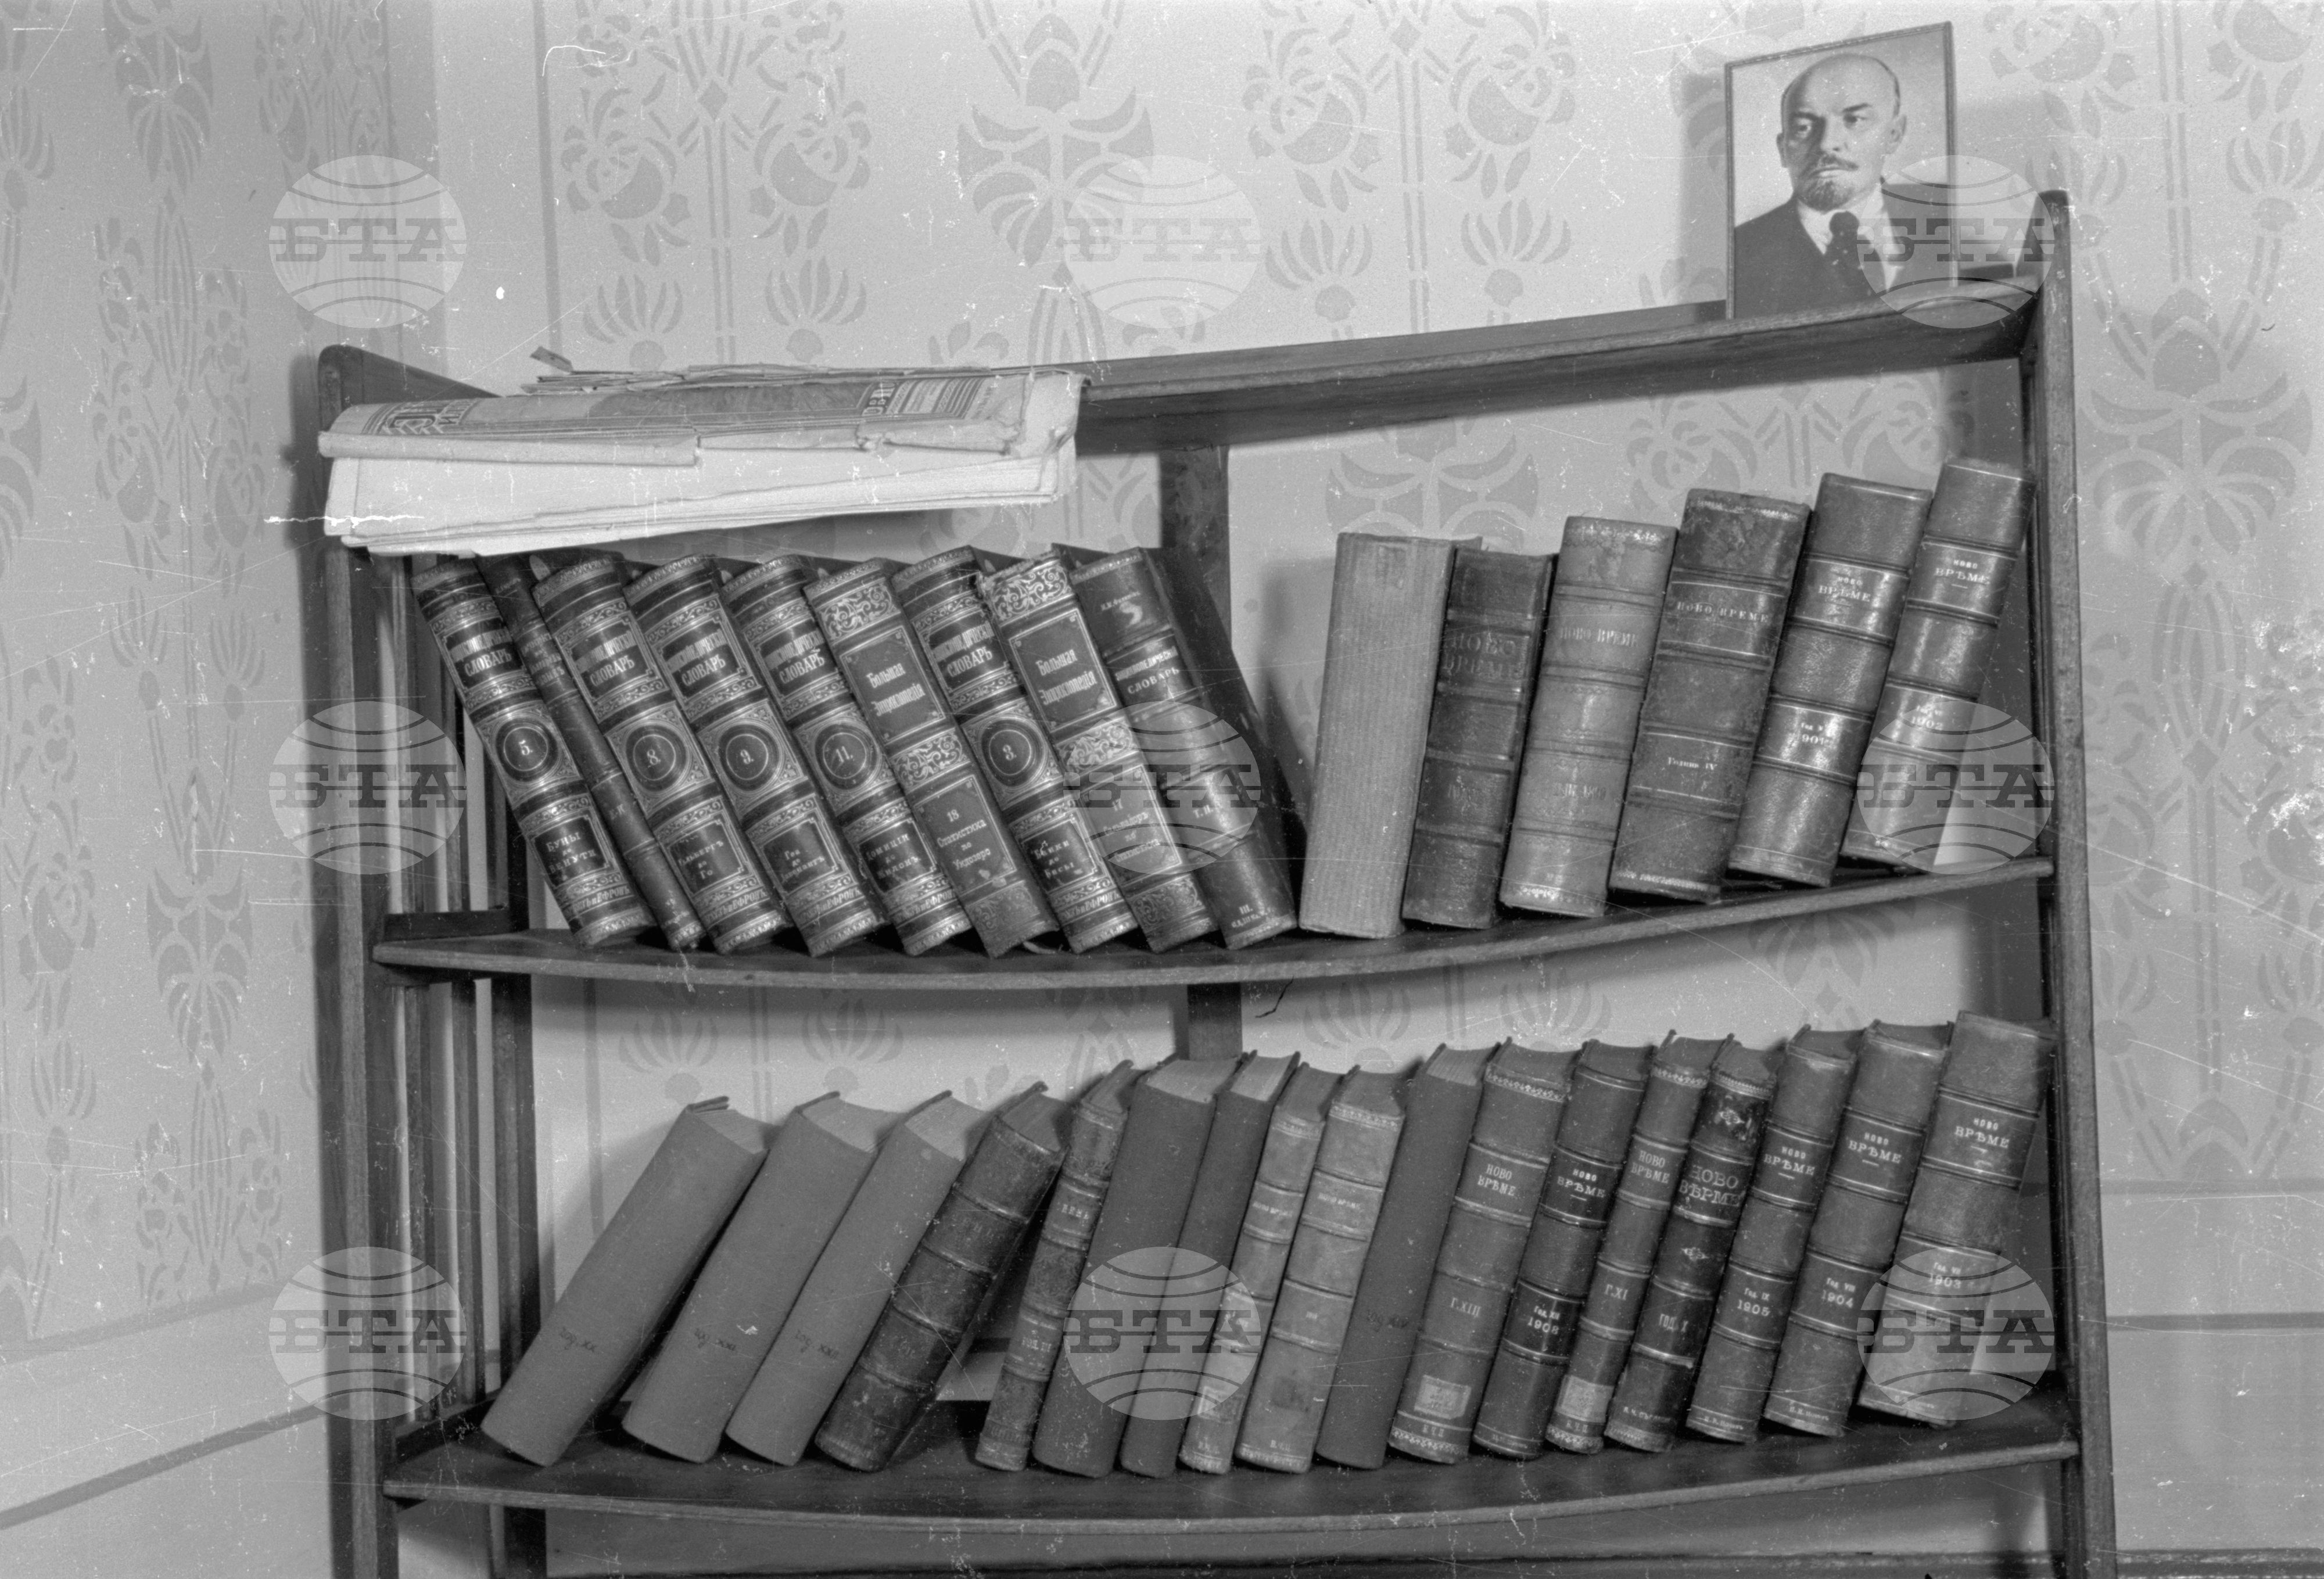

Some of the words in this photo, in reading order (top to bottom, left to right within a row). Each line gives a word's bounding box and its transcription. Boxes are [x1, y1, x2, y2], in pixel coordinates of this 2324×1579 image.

[1953, 560, 1978, 569] НОВО
[1677, 602, 1713, 615] НОВО
[464, 650, 513, 675] СЛОВАРЬ
[682, 657, 726, 684] СЛОВАРЬ
[779, 656, 825, 683] СЛОВАРЬ
[946, 648, 994, 676] СЛОВАРЬ
[1035, 649, 1079, 675] Большая
[590, 658, 635, 685] СЛОВАРЬ
[867, 663, 906, 687] Большая
[1127, 666, 1180, 693] СЛОВАРЬ
[1911, 715, 1943, 730] 1902
[740, 749, 754, 765] 9.
[835, 746, 854, 762] 11.
[1111, 799, 1124, 812] 17
[946, 809, 960, 822] 18
[936, 819, 988, 846] Статистика
[546, 831, 582, 852] БУНЫ
[548, 848, 597, 873] ВЕНУТИ
[952, 847, 992, 869] Ундозеро
[1974, 1118, 1999, 1131] НОВО
[1864, 1132, 1889, 1146] НОВО
[1955, 1126, 2010, 1149] ВРѢМЕ
[1638, 1151, 1666, 1168] НОВО
[1782, 1146, 1806, 1160] НОВО
[1848, 1139, 1902, 1164] ВРѢМЕ
[1486, 1165, 1512, 1180] НОВО
[1764, 1153, 1815, 1176] ВРѢМЕ
[1573, 1169, 1597, 1182] НОВО
[1630, 1164, 1670, 1185] ВРѢМЕ
[1690, 1165, 1738, 1189] НОВО
[1477, 1176, 1516, 1197] ВРѢМЕ
[1557, 1177, 1605, 1198] ВРѢМЕ
[1934, 1262, 1949, 1275] Год
[1827, 1277, 1842, 1291] Год
[1930, 1273, 1962, 1290] 1903
[1744, 1287, 1760, 1301] Год
[1761, 1293, 1770, 1302] IX
[1822, 1290, 1854, 1308] 1904
[1534, 1305, 1547, 1319] Год
[1737, 1300, 1771, 1317] 1905
[1528, 1317, 1559, 1334] 1908
